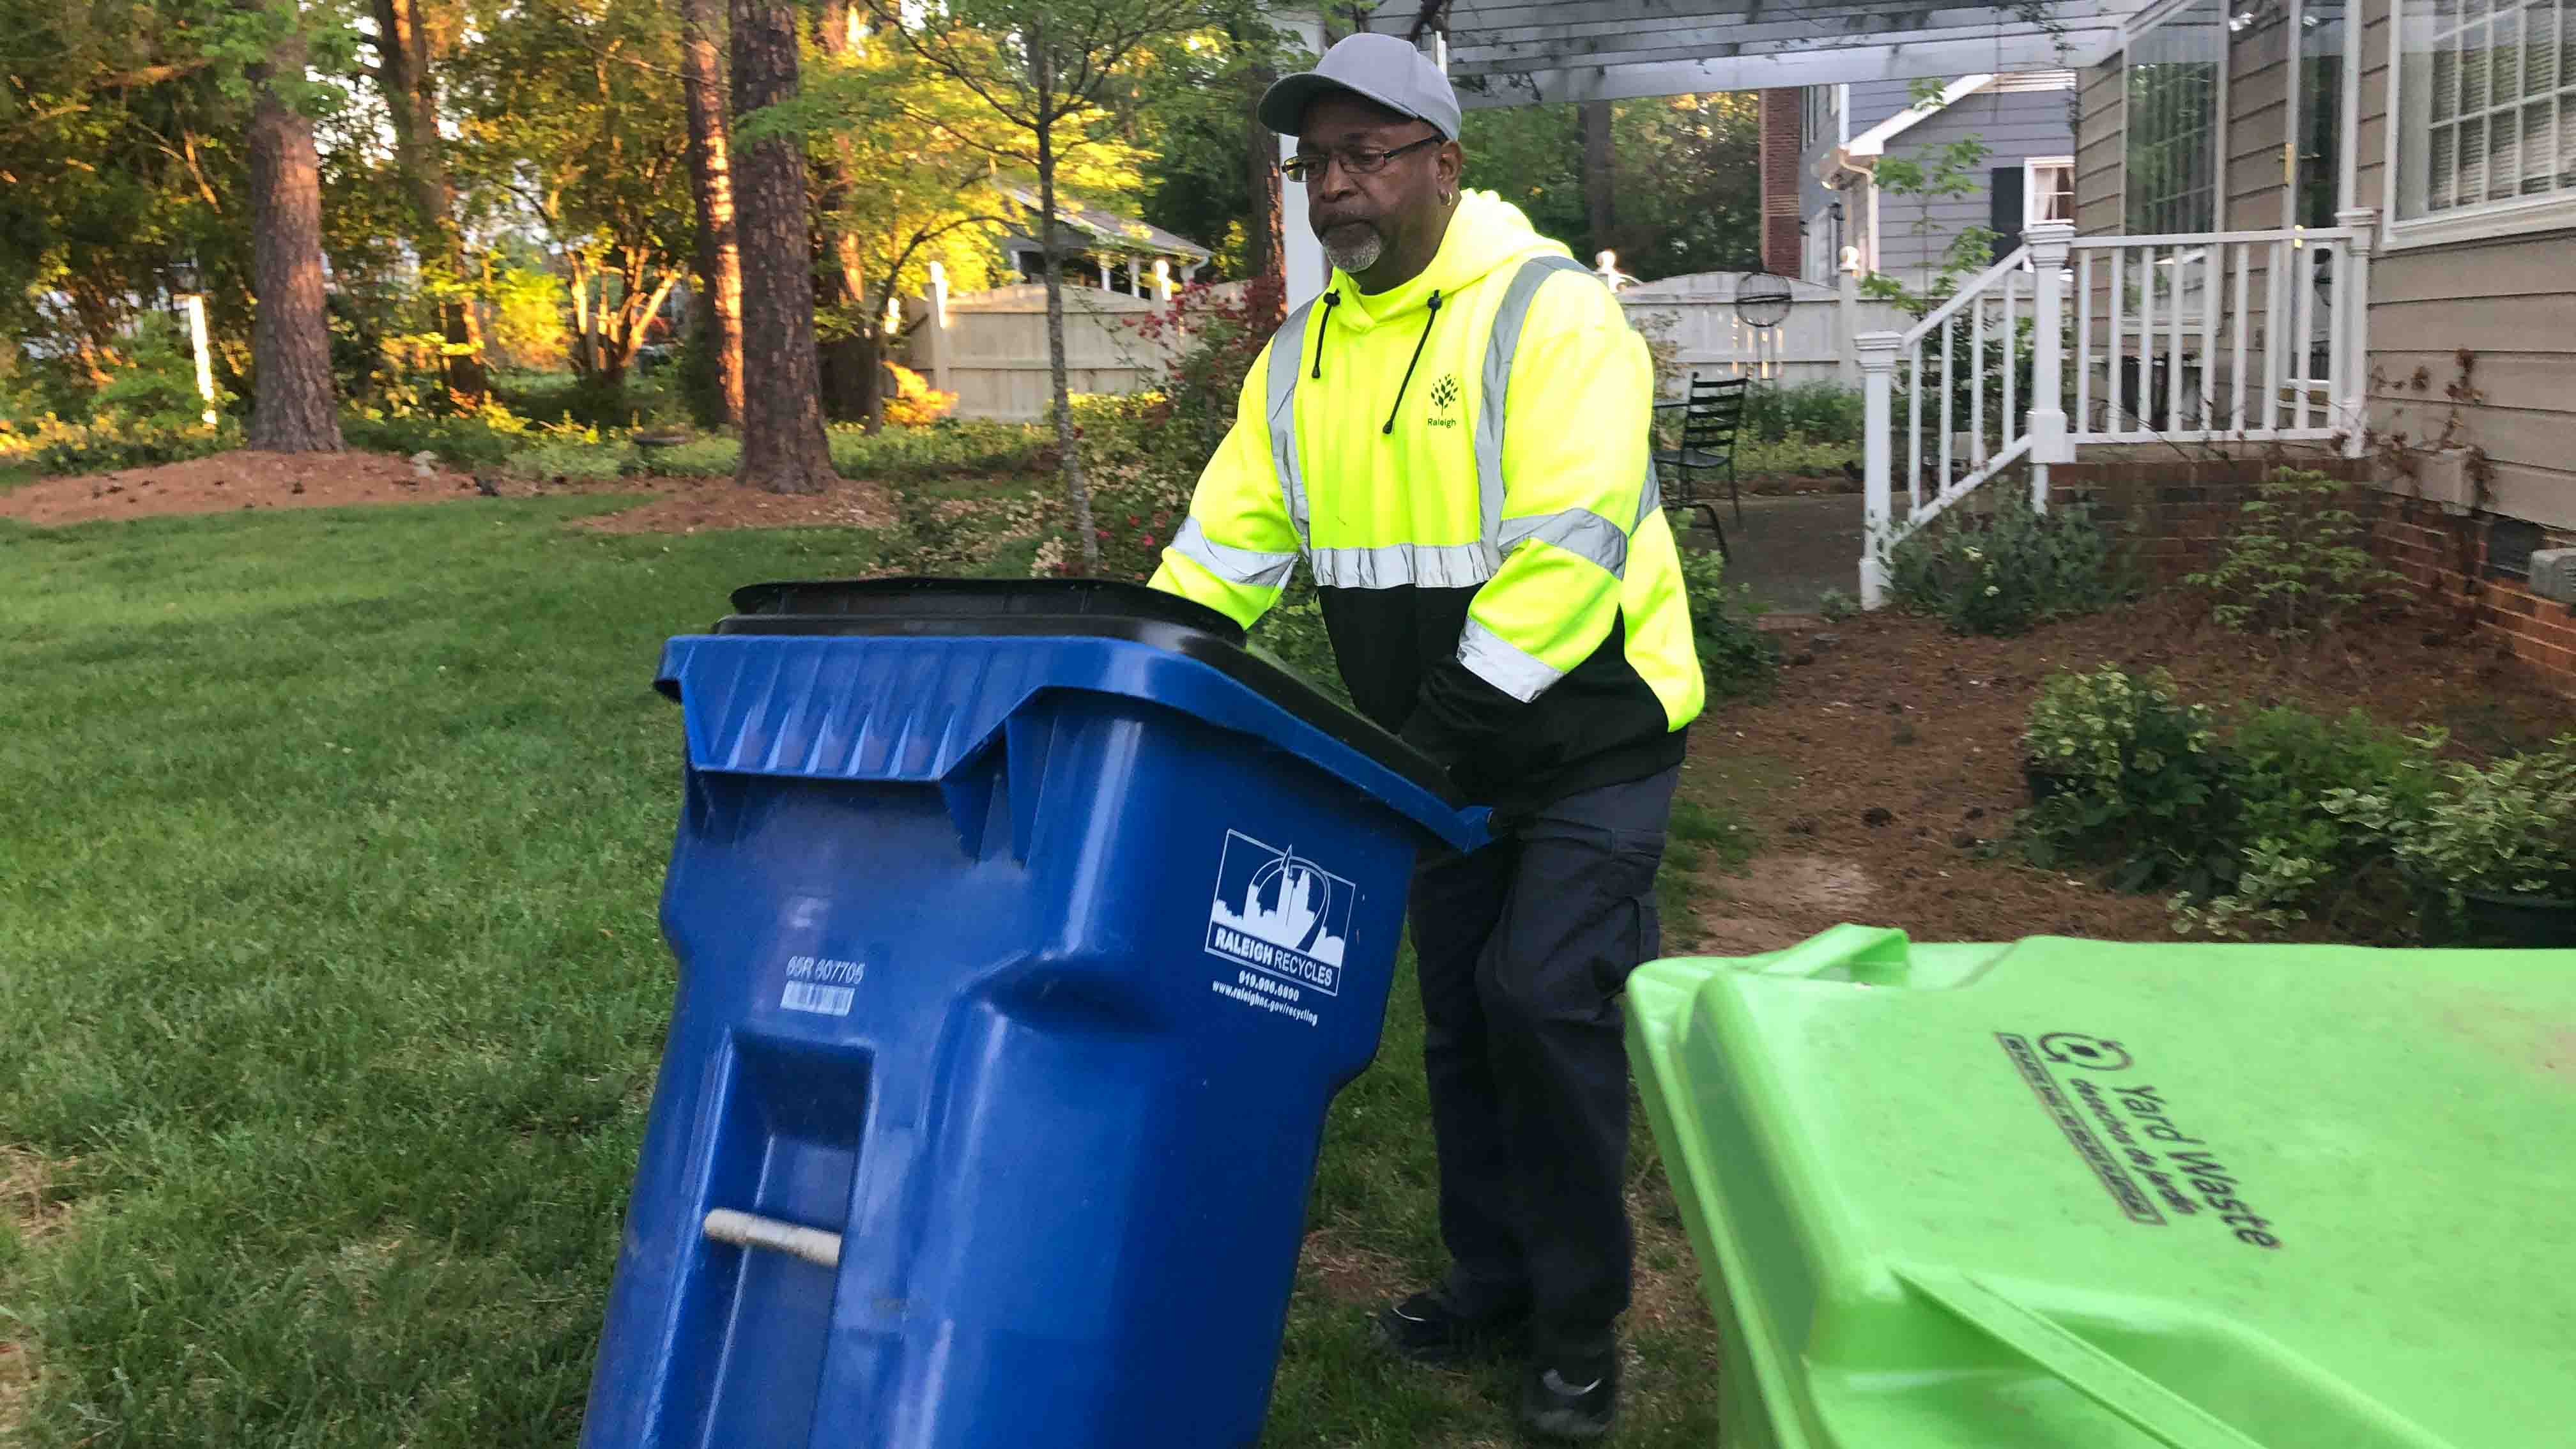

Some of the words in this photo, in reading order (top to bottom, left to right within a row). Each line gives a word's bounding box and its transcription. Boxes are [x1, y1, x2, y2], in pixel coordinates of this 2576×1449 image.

[1427, 417, 1456, 428] Raleigh
[1215, 928, 1273, 965] RALEIGH
[1273, 951, 1333, 986] RECYCLES
[2110, 1085, 2206, 1145] Yard
[2166, 1151, 2283, 1249] Waste
